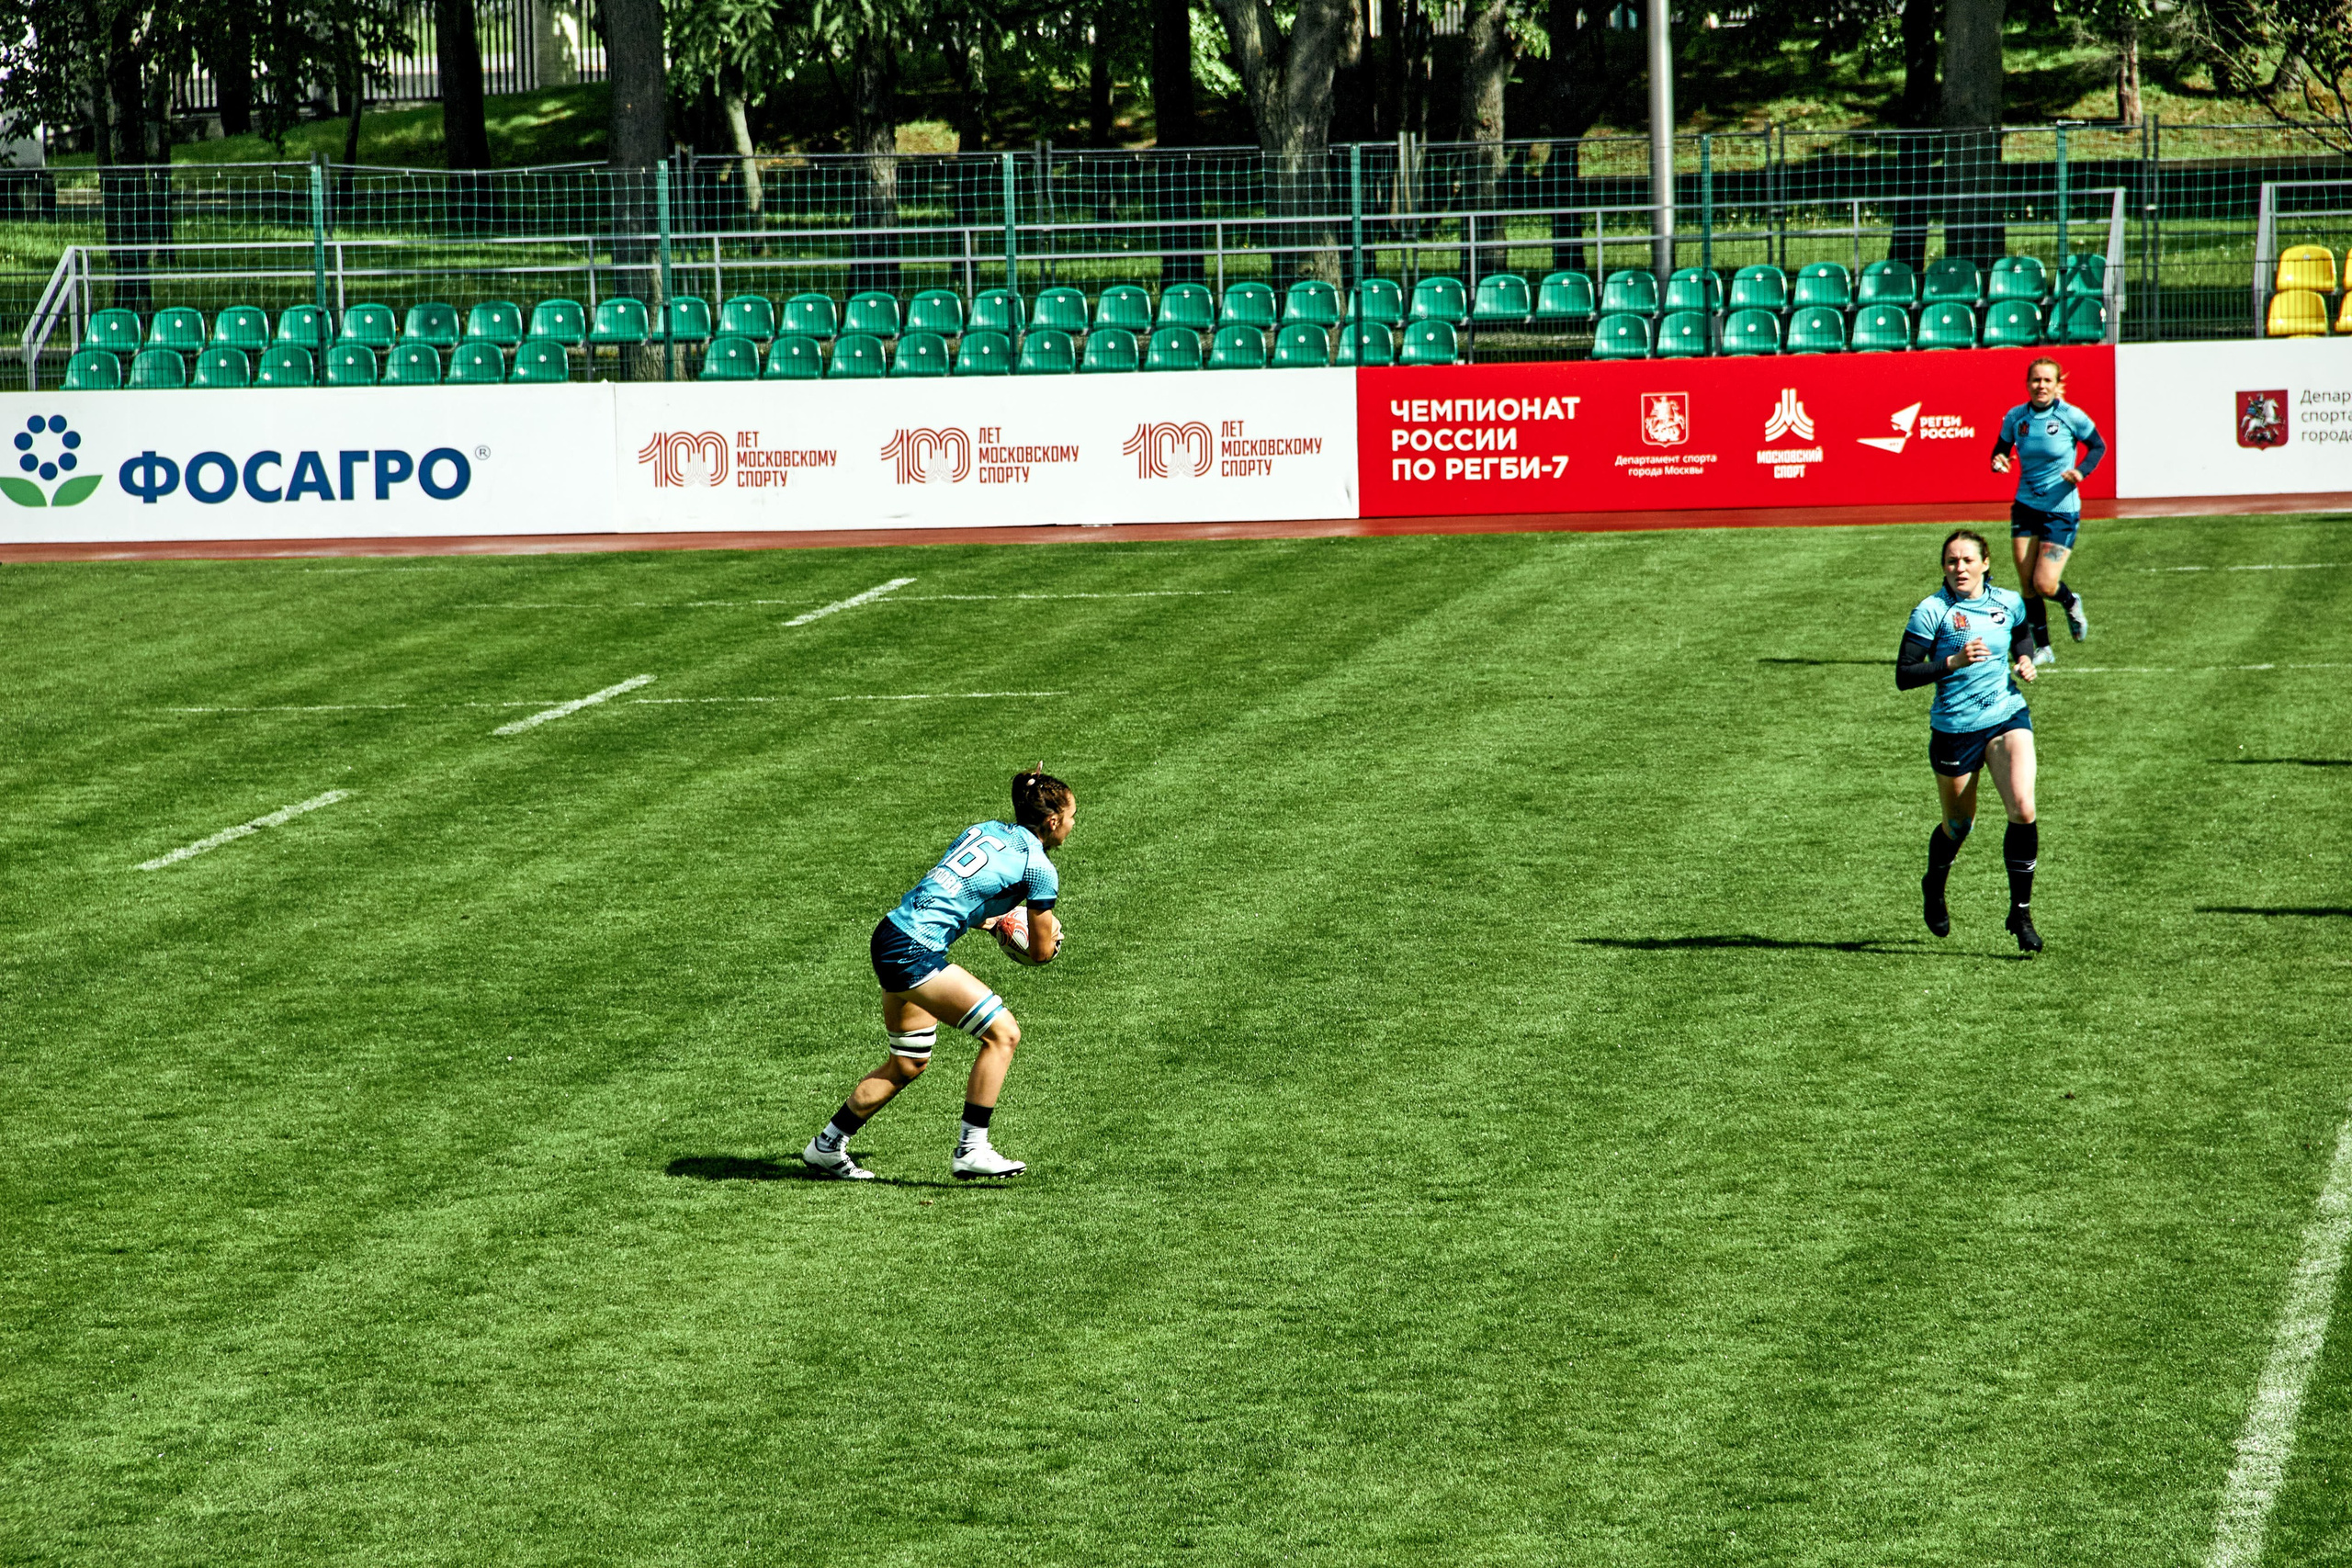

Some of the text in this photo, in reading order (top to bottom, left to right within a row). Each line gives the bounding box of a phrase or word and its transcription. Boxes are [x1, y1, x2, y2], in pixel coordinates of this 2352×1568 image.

[2301, 389, 2352, 405] Депар
[1390, 396, 1581, 423] ЧЕМПИОНАТ
[1221, 421, 1245, 438] ЛЕТ
[1919, 415, 1962, 428] РЕГБИ
[737, 431, 760, 448] ЛЕТ
[978, 427, 1002, 445] ЛЕТ
[1391, 427, 1518, 452] РОССИИ
[1919, 426, 1975, 440] РОССИИ
[881, 427, 970, 484] 100
[978, 446, 1080, 464] МОСКОВСКОМУ
[1123, 422, 1213, 479] 100
[1221, 438, 1322, 457] МОСКОВСКОМУ
[1757, 446, 1824, 464] МОСКОВСКИЙ
[639, 431, 729, 488] 100
[737, 450, 837, 468] МОСКОВСКОМУ
[1392, 455, 1569, 481] ПО РЕГБИ-7
[1615, 454, 1717, 467] Департамент спорта
[979, 466, 1030, 484] СПОРТУ
[1221, 460, 1272, 478] СПОРТУ
[1628, 465, 1704, 479] города Москвы
[1773, 464, 1806, 479] СПОРТ
[737, 469, 787, 488] СПОРТУ
[940, 827, 1007, 878] 16
